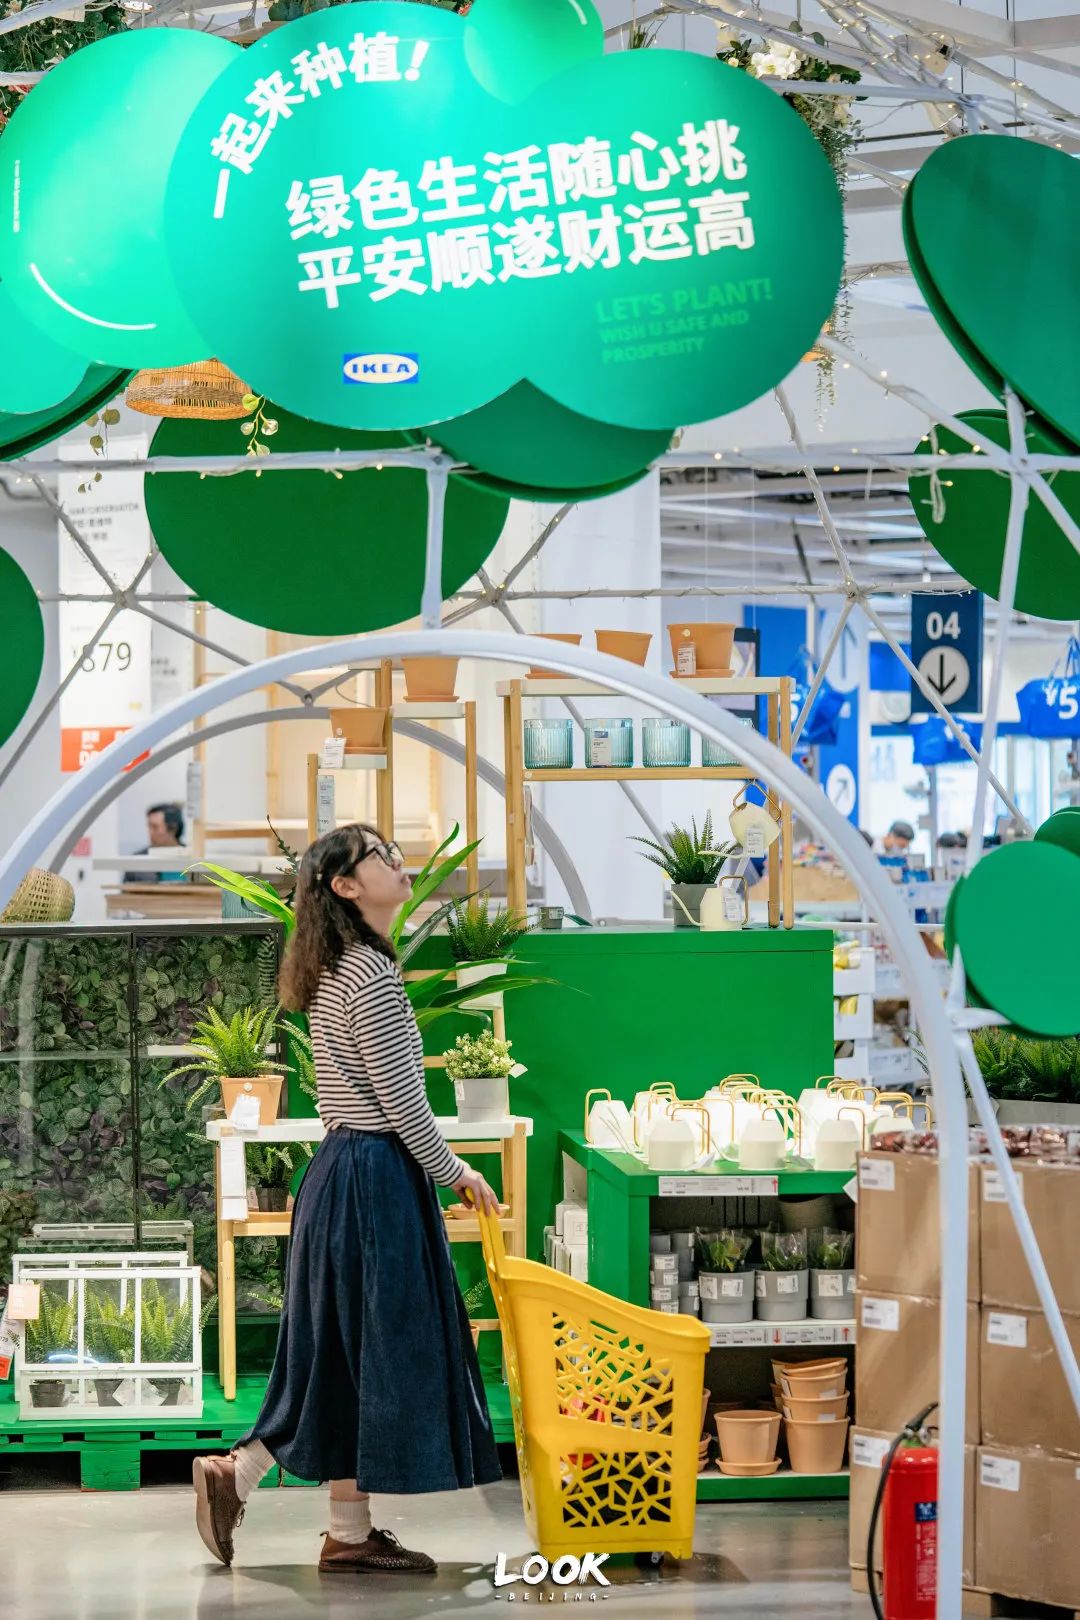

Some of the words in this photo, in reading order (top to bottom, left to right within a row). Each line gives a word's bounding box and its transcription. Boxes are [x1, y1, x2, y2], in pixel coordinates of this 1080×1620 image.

[210, 32, 429, 219] 一起来种植！
[286, 119, 748, 241] 绿色生活随心挑
[299, 190, 756, 309] 平安顺遂财运高
[596, 292, 667, 323] LET'S
[671, 277, 773, 313] PLANT!
[664, 315, 708, 335] SAFE
[711, 309, 749, 328] AND
[601, 337, 705, 364] PROSPERITY
[926, 611, 961, 641] 04
